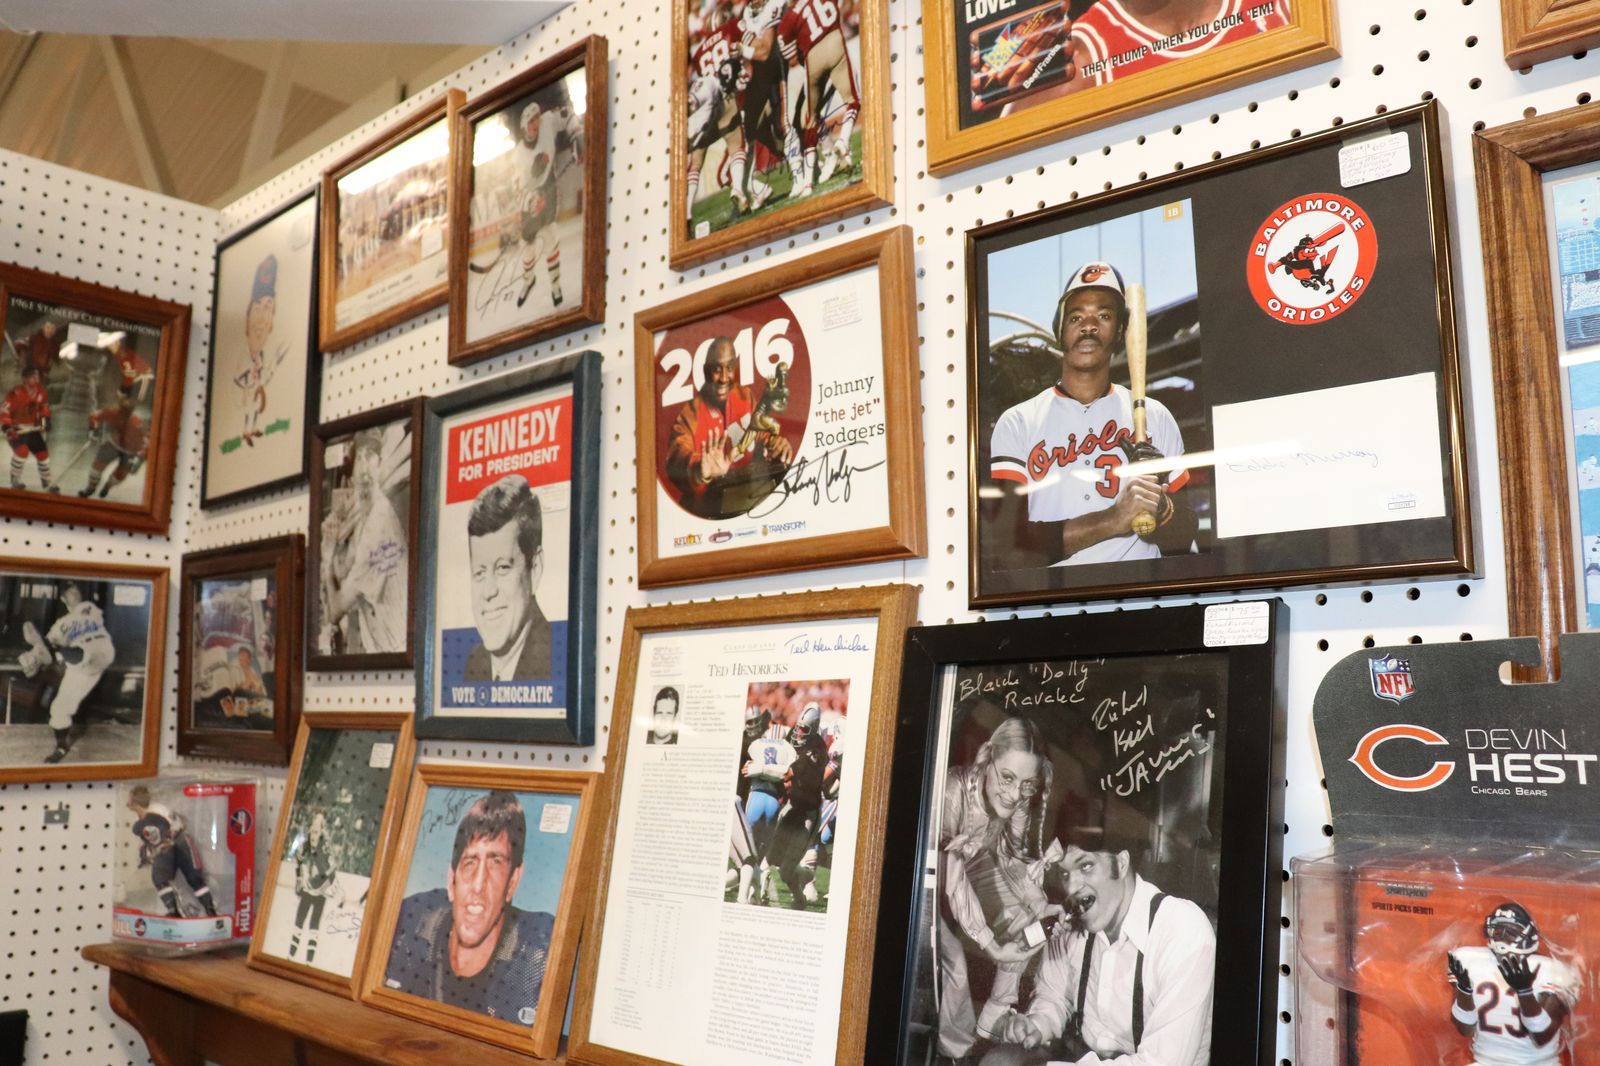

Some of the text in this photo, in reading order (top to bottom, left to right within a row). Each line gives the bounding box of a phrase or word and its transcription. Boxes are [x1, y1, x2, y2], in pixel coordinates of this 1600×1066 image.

[1081, 62, 1109, 79] THEY
[1111, 44, 1148, 67] PLUMP
[1151, 31, 1185, 53] WHEN
[1187, 23, 1210, 41] YOU
[1212, 11, 1244, 33] COOK
[1255, 199, 1366, 257] BALTIMORE
[1267, 275, 1366, 321] ORIOLES
[817, 376, 874, 403] Johnny
[459, 405, 561, 463] KENNEDY
[814, 422, 885, 448] Rodgers
[458, 445, 560, 483] FOR PRESIDENT
[1094, 454, 1122, 499] 3
[708, 662, 788, 677] TED HENDRICKS
[451, 685, 554, 704] VOTE DEMOCRATIC
[1376, 672, 1416, 697] NFL
[1465, 728, 1567, 751] DEVIN
[1470, 785, 1549, 797] CHICAGO BEARS
